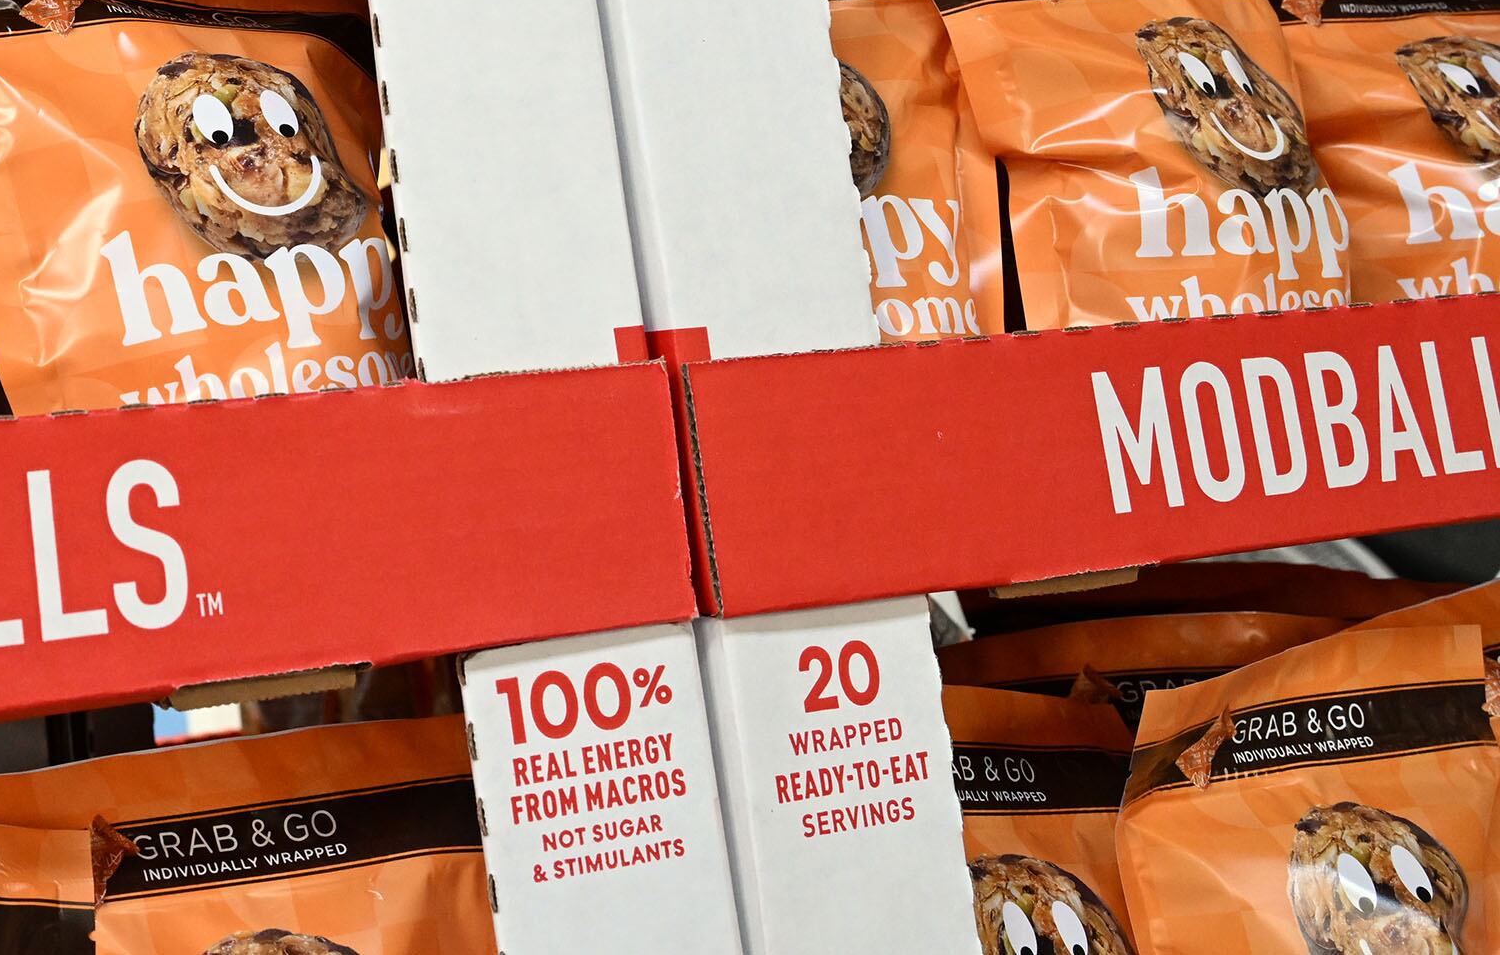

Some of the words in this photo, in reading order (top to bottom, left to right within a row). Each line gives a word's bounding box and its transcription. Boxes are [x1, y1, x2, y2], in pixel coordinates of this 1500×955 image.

[1338, 3, 1399, 14] INDIVIDUALLY
[1399, 2, 1449, 13] WRAPPED
[1128, 166, 1350, 281] happ
[1388, 161, 1500, 245] h
[860, 194, 960, 288] py
[799, 639, 881, 714] 20
[495, 661, 673, 745] 100%
[1231, 710, 1298, 744] GRAB
[1306, 707, 1324, 735] &
[1327, 702, 1366, 732] GO
[512, 749, 579, 786] REAL
[582, 732, 673, 775] ENERGY
[788, 716, 903, 757] WRAPPED
[1232, 741, 1313, 765] INDIVIDUALLY
[1313, 735, 1375, 754] WRAPPED
[775, 750, 930, 805] READY-TO-EAT
[984, 755, 1001, 782] &
[1004, 756, 1035, 784] GO
[509, 787, 579, 826] FROM
[586, 767, 687, 811] MACROS
[801, 796, 916, 839] SERVINGS
[990, 790, 1048, 803] WRAPPED
[131, 823, 239, 861] GRAB
[251, 817, 277, 848] &
[283, 809, 338, 839] GO
[541, 825, 587, 852] NOT
[592, 813, 663, 842] SUGAR
[142, 855, 261, 883] INDIVIDUALLY
[263, 842, 349, 867] WRAPPED
[532, 863, 549, 884] &
[552, 838, 685, 878] STIMULANTS
